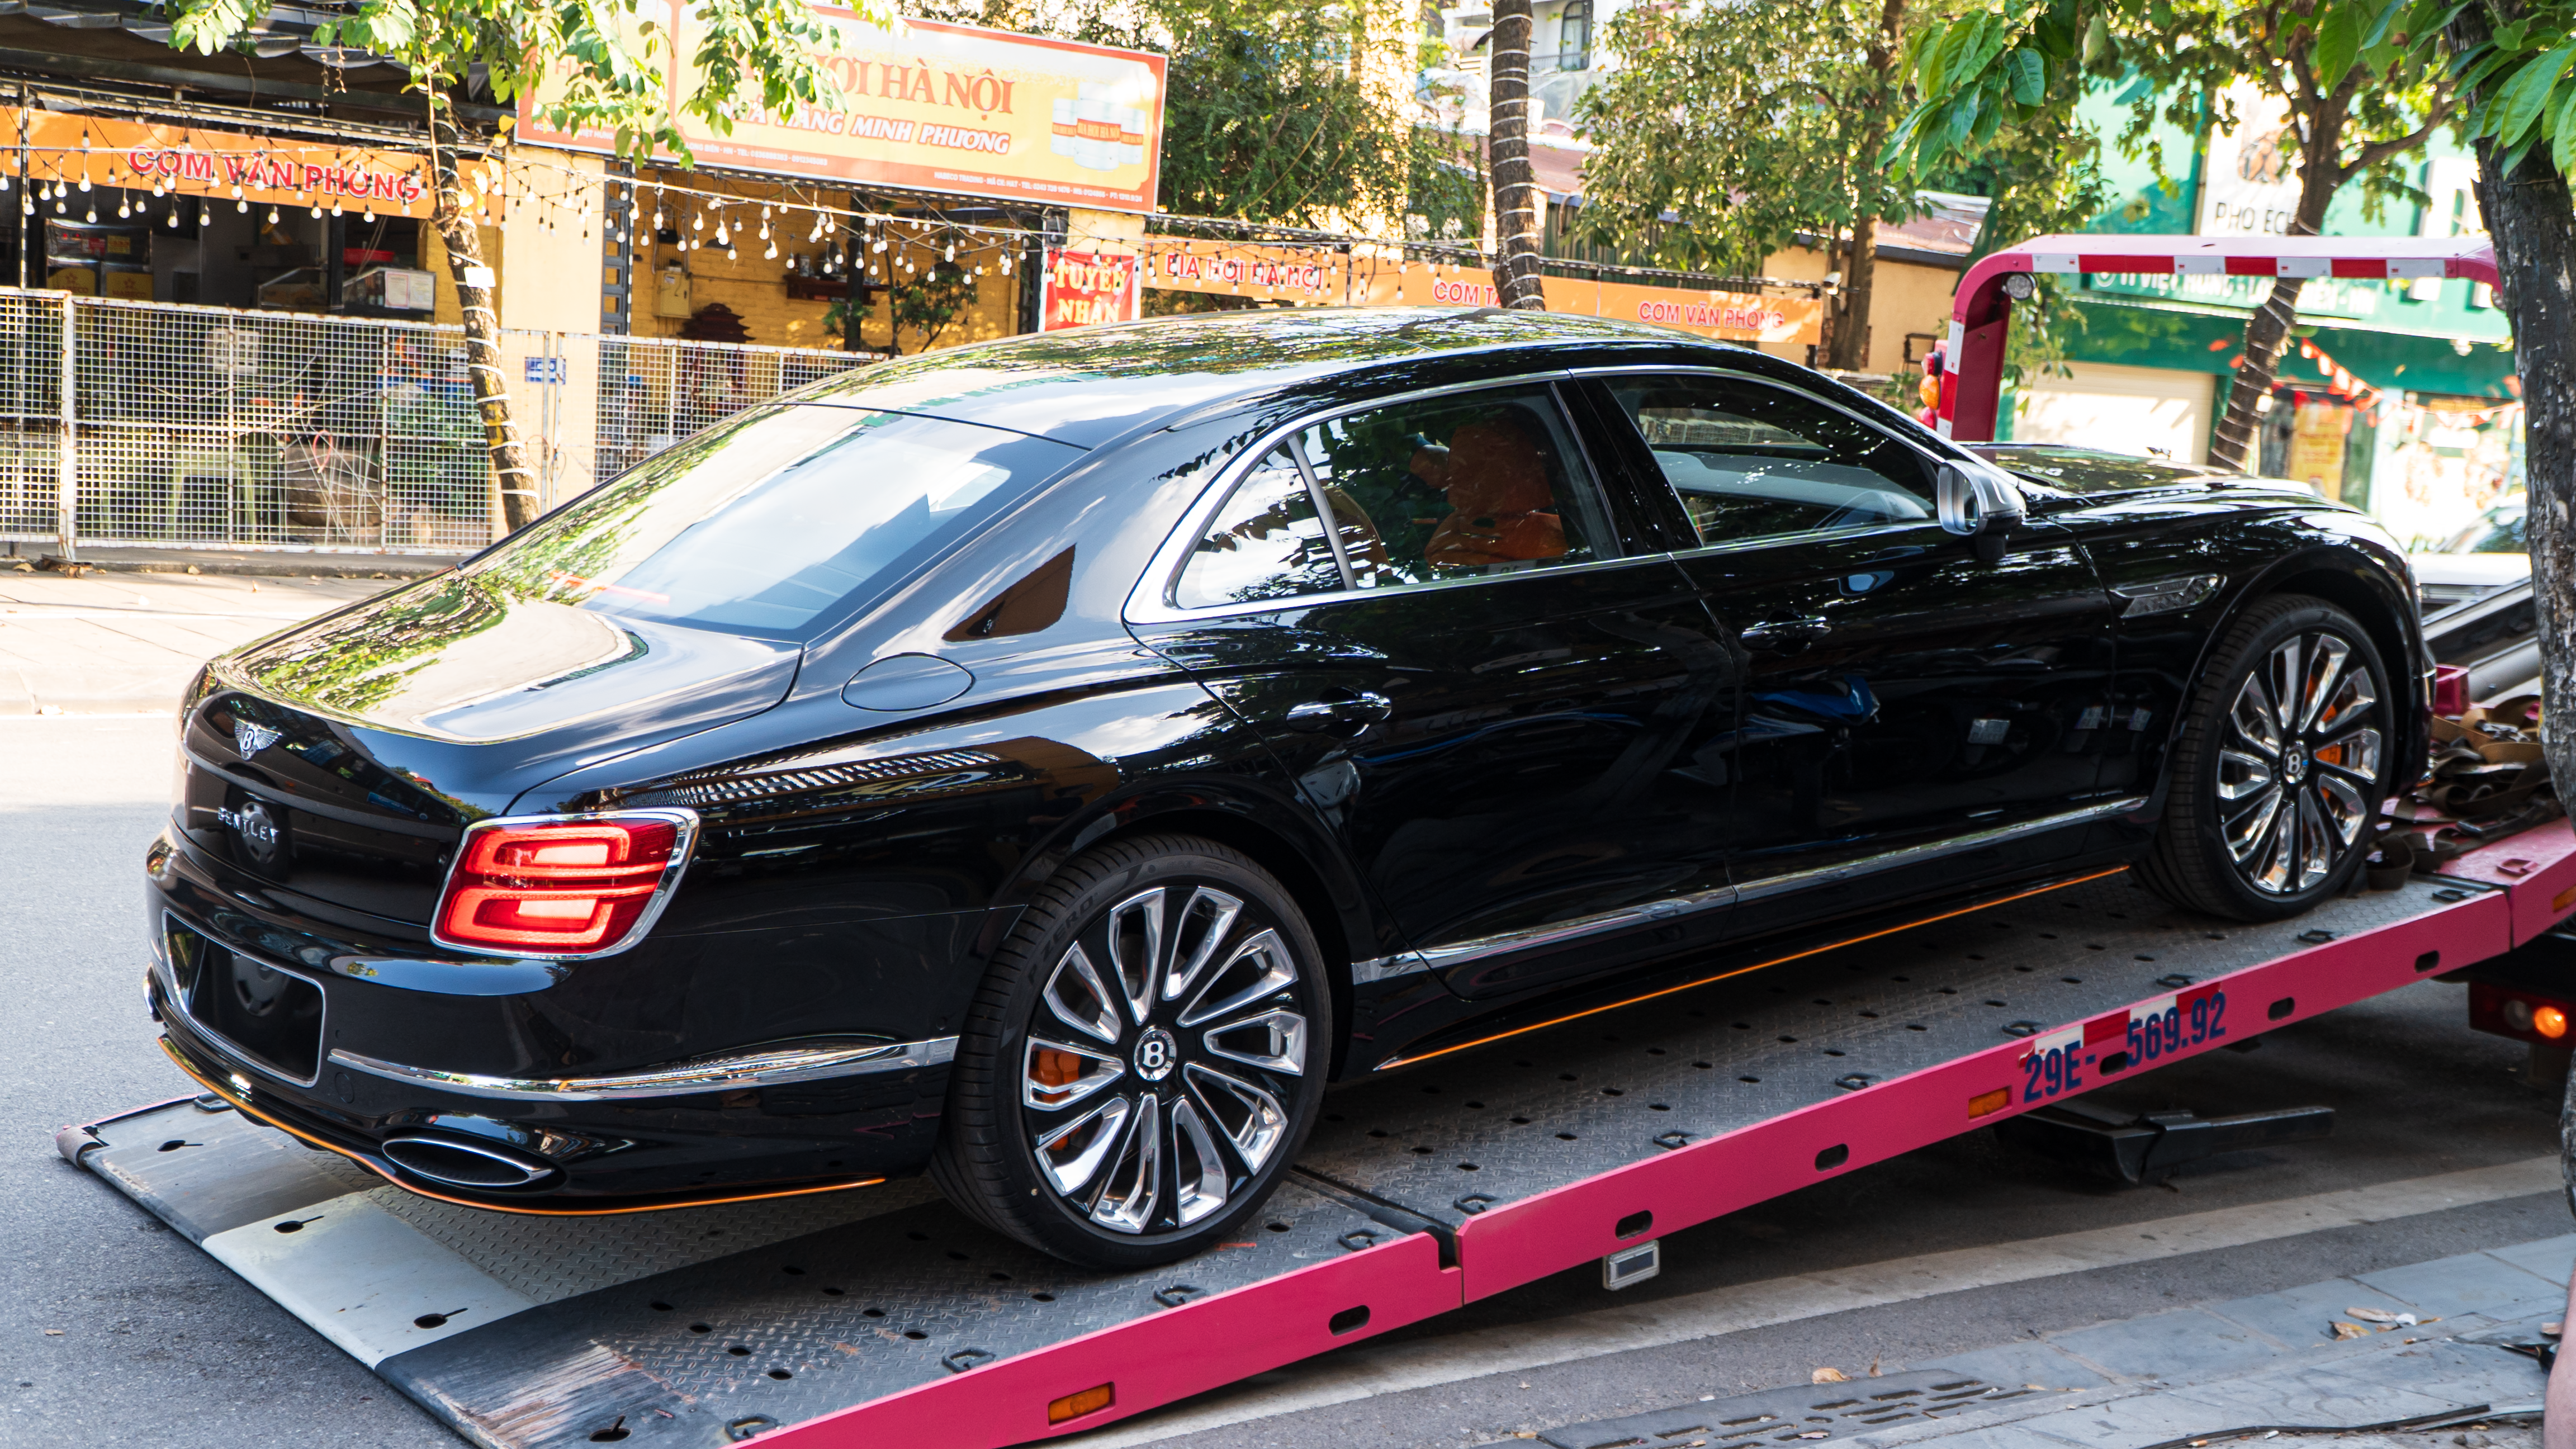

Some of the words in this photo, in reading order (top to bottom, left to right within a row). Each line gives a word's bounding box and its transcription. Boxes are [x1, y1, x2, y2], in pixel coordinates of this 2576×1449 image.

[878, 58, 939, 105] HÀ
[942, 69, 1015, 120] NỘI
[850, 114, 915, 143] MINH
[918, 122, 1010, 155] PHƯƠNG
[128, 145, 213, 182] CƠM
[224, 150, 293, 191] VĂN
[1057, 295, 1120, 325] NHÂN
[1433, 280, 1480, 306] CƠM
[1637, 300, 1680, 324] CƠM
[1685, 301, 1721, 327] VĂN
[218, 807, 280, 844] BENTLEY
[1142, 1041, 1164, 1068] B
[2023, 1039, 2096, 1104] 29E-
[2126, 991, 2227, 1068] 569.92
